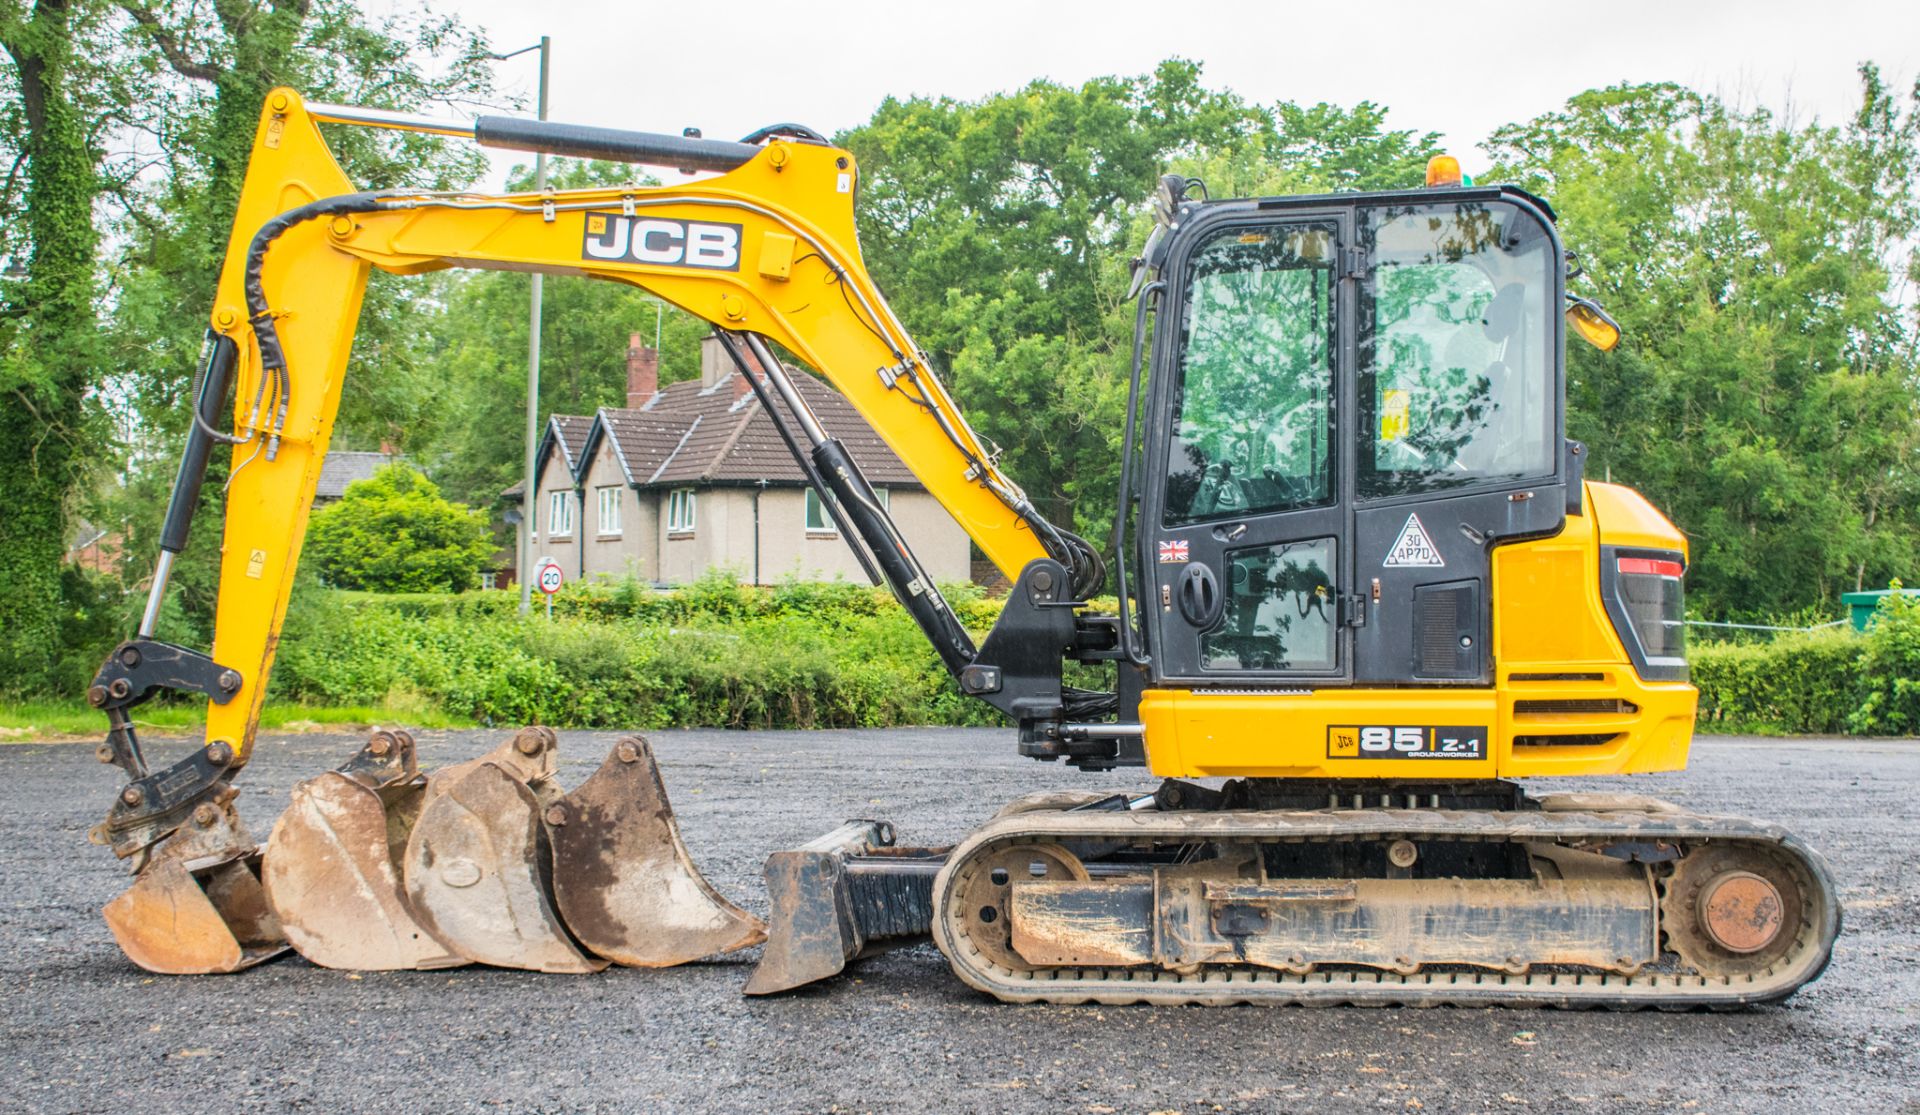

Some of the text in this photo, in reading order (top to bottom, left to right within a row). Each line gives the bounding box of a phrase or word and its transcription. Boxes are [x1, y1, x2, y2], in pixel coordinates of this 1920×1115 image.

[586, 217, 738, 267] JCB
[1405, 534, 1421, 547] 30
[544, 573, 560, 585] 20
[1337, 735, 1354, 749] JCB
[1361, 727, 1479, 752] 85 Z-1
